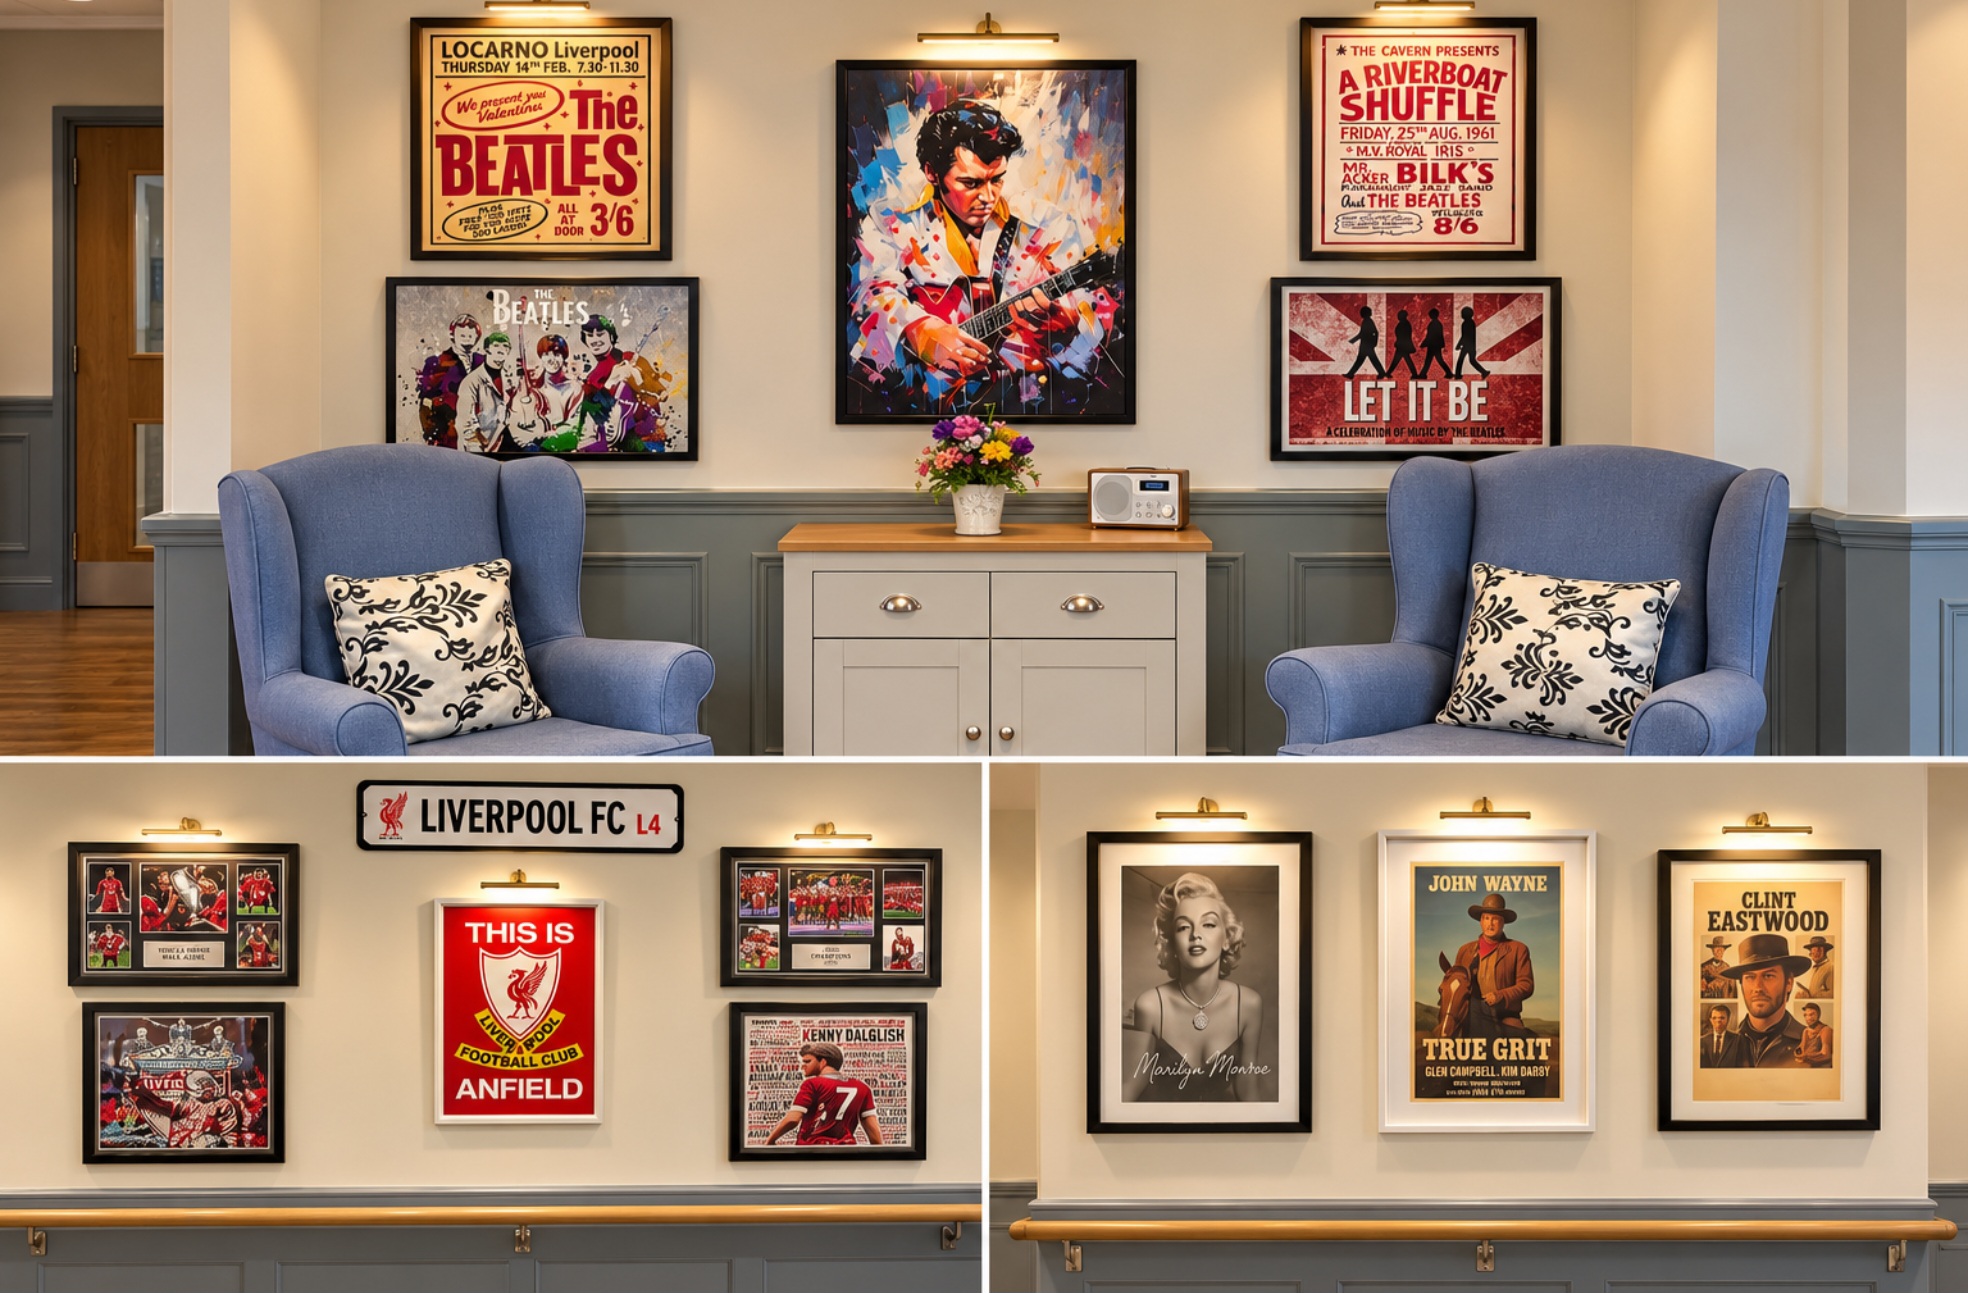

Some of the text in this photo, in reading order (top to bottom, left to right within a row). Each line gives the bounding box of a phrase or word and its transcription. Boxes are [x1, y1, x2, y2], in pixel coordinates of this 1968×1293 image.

[441, 41, 639, 62] LOCARNO Liverpool
[1350, 45, 1500, 57] THE CAVERN PRESENTS
[441, 61, 511, 74] THURSDAY
[515, 61, 541, 74] 14TH
[1338, 59, 1509, 95] A RIVERBOAT
[569, 89, 638, 130] The
[1339, 86, 1497, 122] SHUFFLE
[1397, 126, 1428, 140] 25TH
[1428, 126, 1462, 140] AUG.
[1466, 126, 1495, 140] 1961
[1356, 145, 1464, 157] M.V. ROYAL IRIS
[435, 134, 638, 197] BEATLES
[1343, 162, 1372, 173] MR.
[1397, 161, 1495, 185] BILK'S
[1341, 173, 1389, 184] ACKER
[557, 203, 579, 214] ALL
[1367, 193, 1400, 208] THE
[1405, 193, 1481, 208] BEATLES
[560, 215, 576, 225] AT
[590, 202, 634, 237] 3/6
[554, 226, 584, 237] DOOR
[534, 288, 554, 299] THE
[492, 288, 590, 327] BEATLES
[1343, 381, 1489, 422] LET IT BE
[1393, 426, 1405, 438] OF
[421, 798, 661, 835] LIVERPOOL FC L4
[1428, 875, 1548, 892] JOHN WAYNE
[1741, 891, 1797, 909] CLINT
[1707, 910, 1829, 932] EASTWOOD
[465, 922, 575, 944] THIS IS
[802, 1028, 905, 1042] KENNY DALGLISH
[459, 1046, 579, 1068] FOOTBALL CLUB
[1423, 1038, 1552, 1061] TRUE GRIT
[1133, 1052, 1205, 1090] Marilyn
[1425, 1066, 1448, 1077] GLEN
[1501, 1065, 1518, 1077] KIM
[455, 1078, 583, 1100] ANFIELD
[835, 1086, 858, 1121] 7
